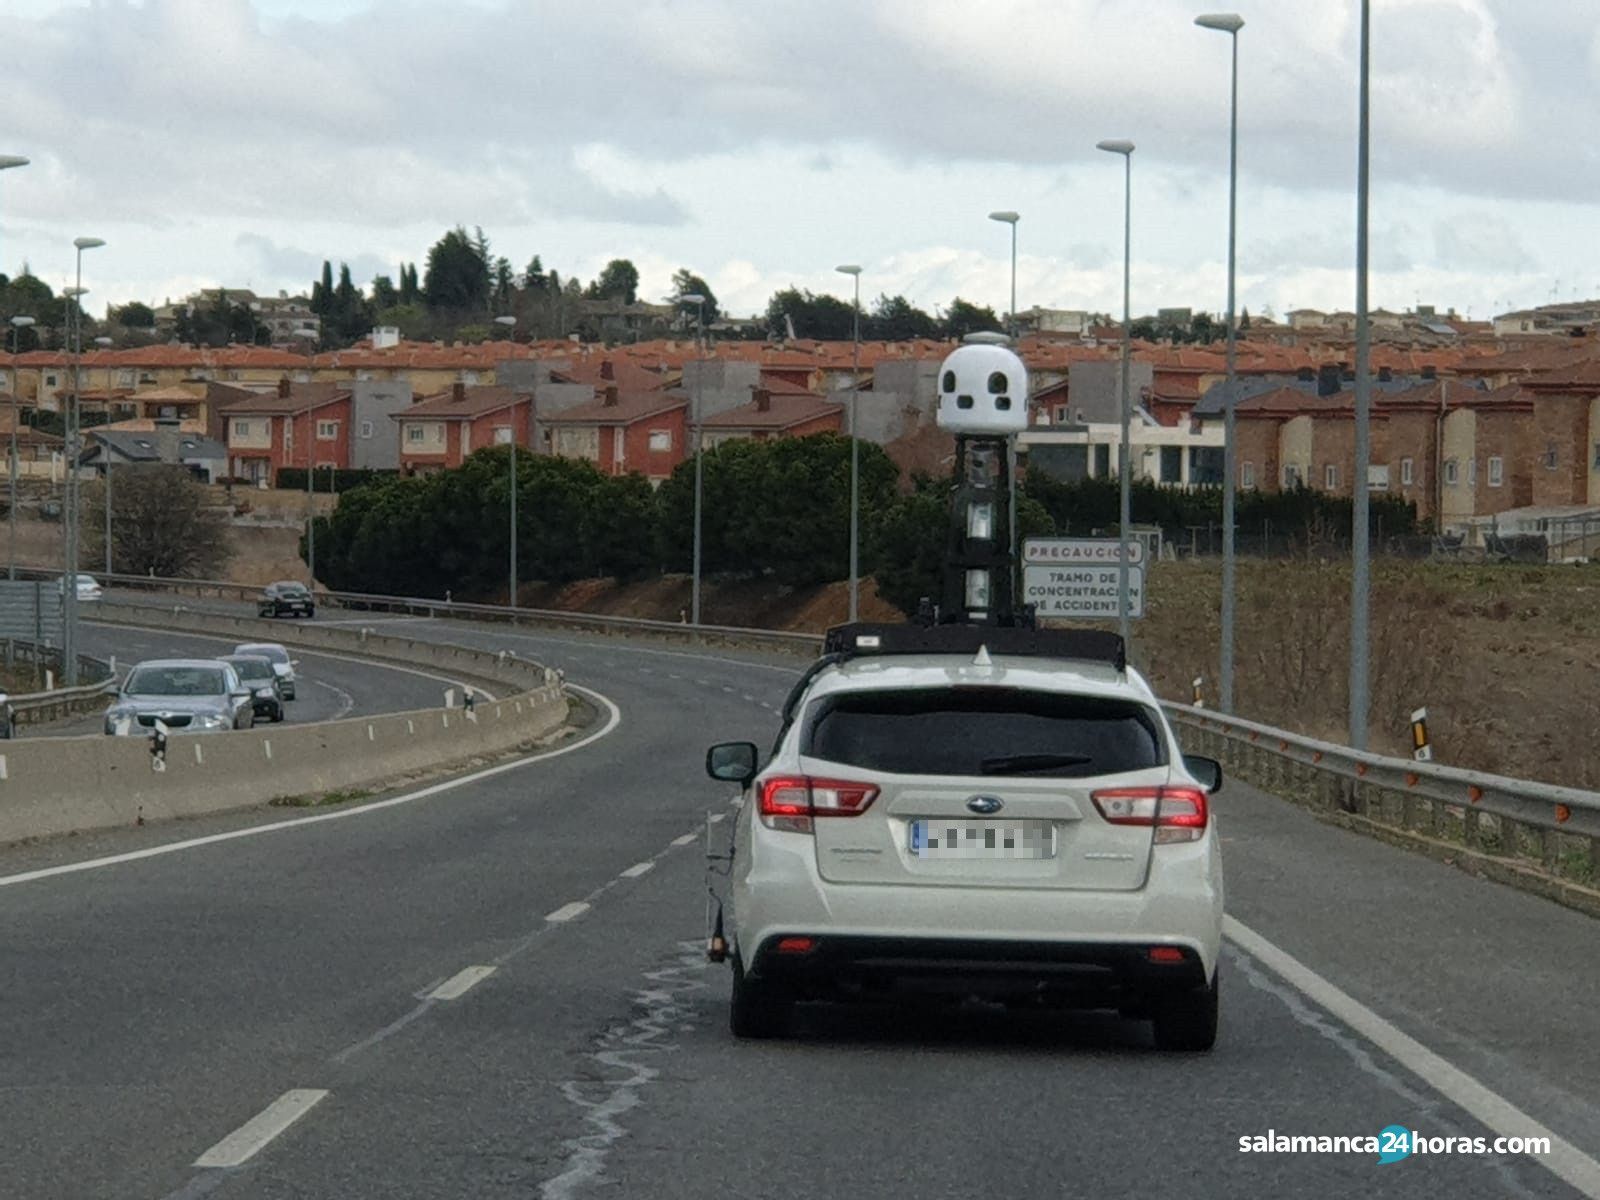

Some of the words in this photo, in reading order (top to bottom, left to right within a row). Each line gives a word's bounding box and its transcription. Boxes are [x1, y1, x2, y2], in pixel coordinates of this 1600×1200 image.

[1049, 572, 1094, 583] TRAMO
[1099, 573, 1117, 583] DE
[1028, 586, 1139, 597] CONCENTRACIN
[1054, 600, 1135, 611] ACCIDENTS
